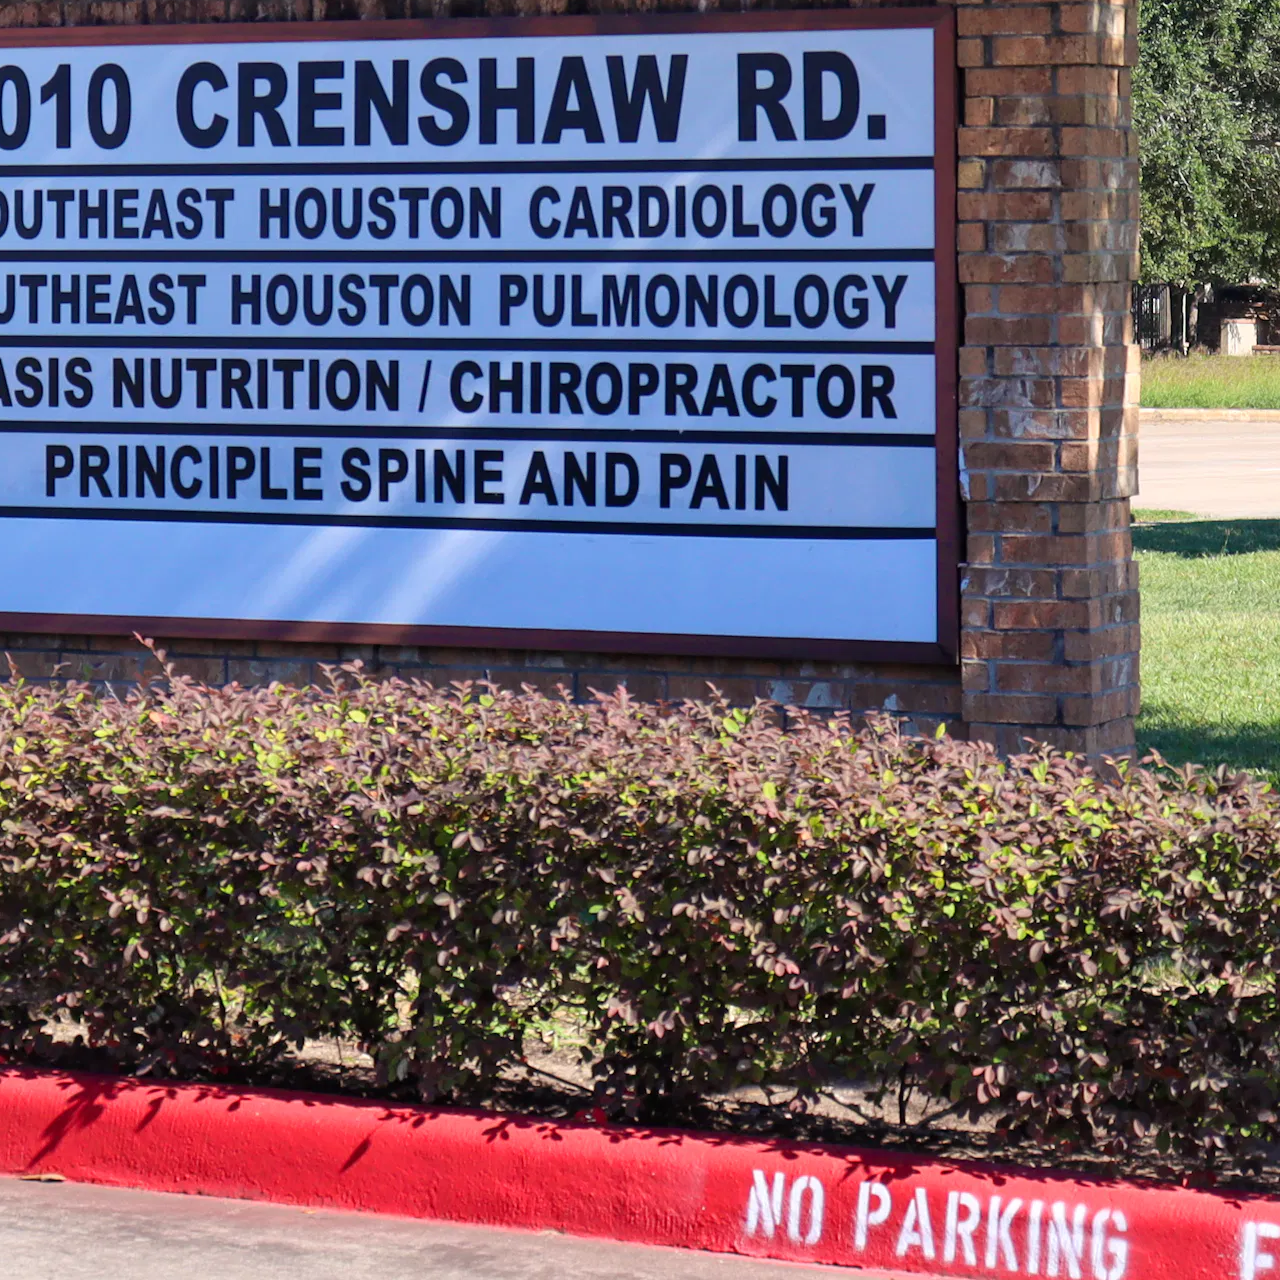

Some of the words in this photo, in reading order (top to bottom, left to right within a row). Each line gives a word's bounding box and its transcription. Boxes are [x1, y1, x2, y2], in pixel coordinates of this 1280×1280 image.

[175, 54, 689, 150] CRENSHAW
[736, 50, 888, 142] RD.
[259, 186, 502, 240] HOUSTON
[528, 182, 876, 239] CARDIOLOGY
[231, 273, 472, 328] HOUSTON
[499, 273, 909, 330] PULMONOLOGY
[112, 357, 400, 412] NUTRITION
[417, 359, 433, 414] /
[449, 361, 898, 420] CHIROPRACTOR
[45, 444, 324, 502] PRINCIPLE
[339, 446, 506, 505] SPINE
[518, 450, 640, 508] AND
[658, 452, 789, 512] PAIN
[744, 1169, 826, 1246] NO
[854, 1181, 1129, 1280] PARKING
